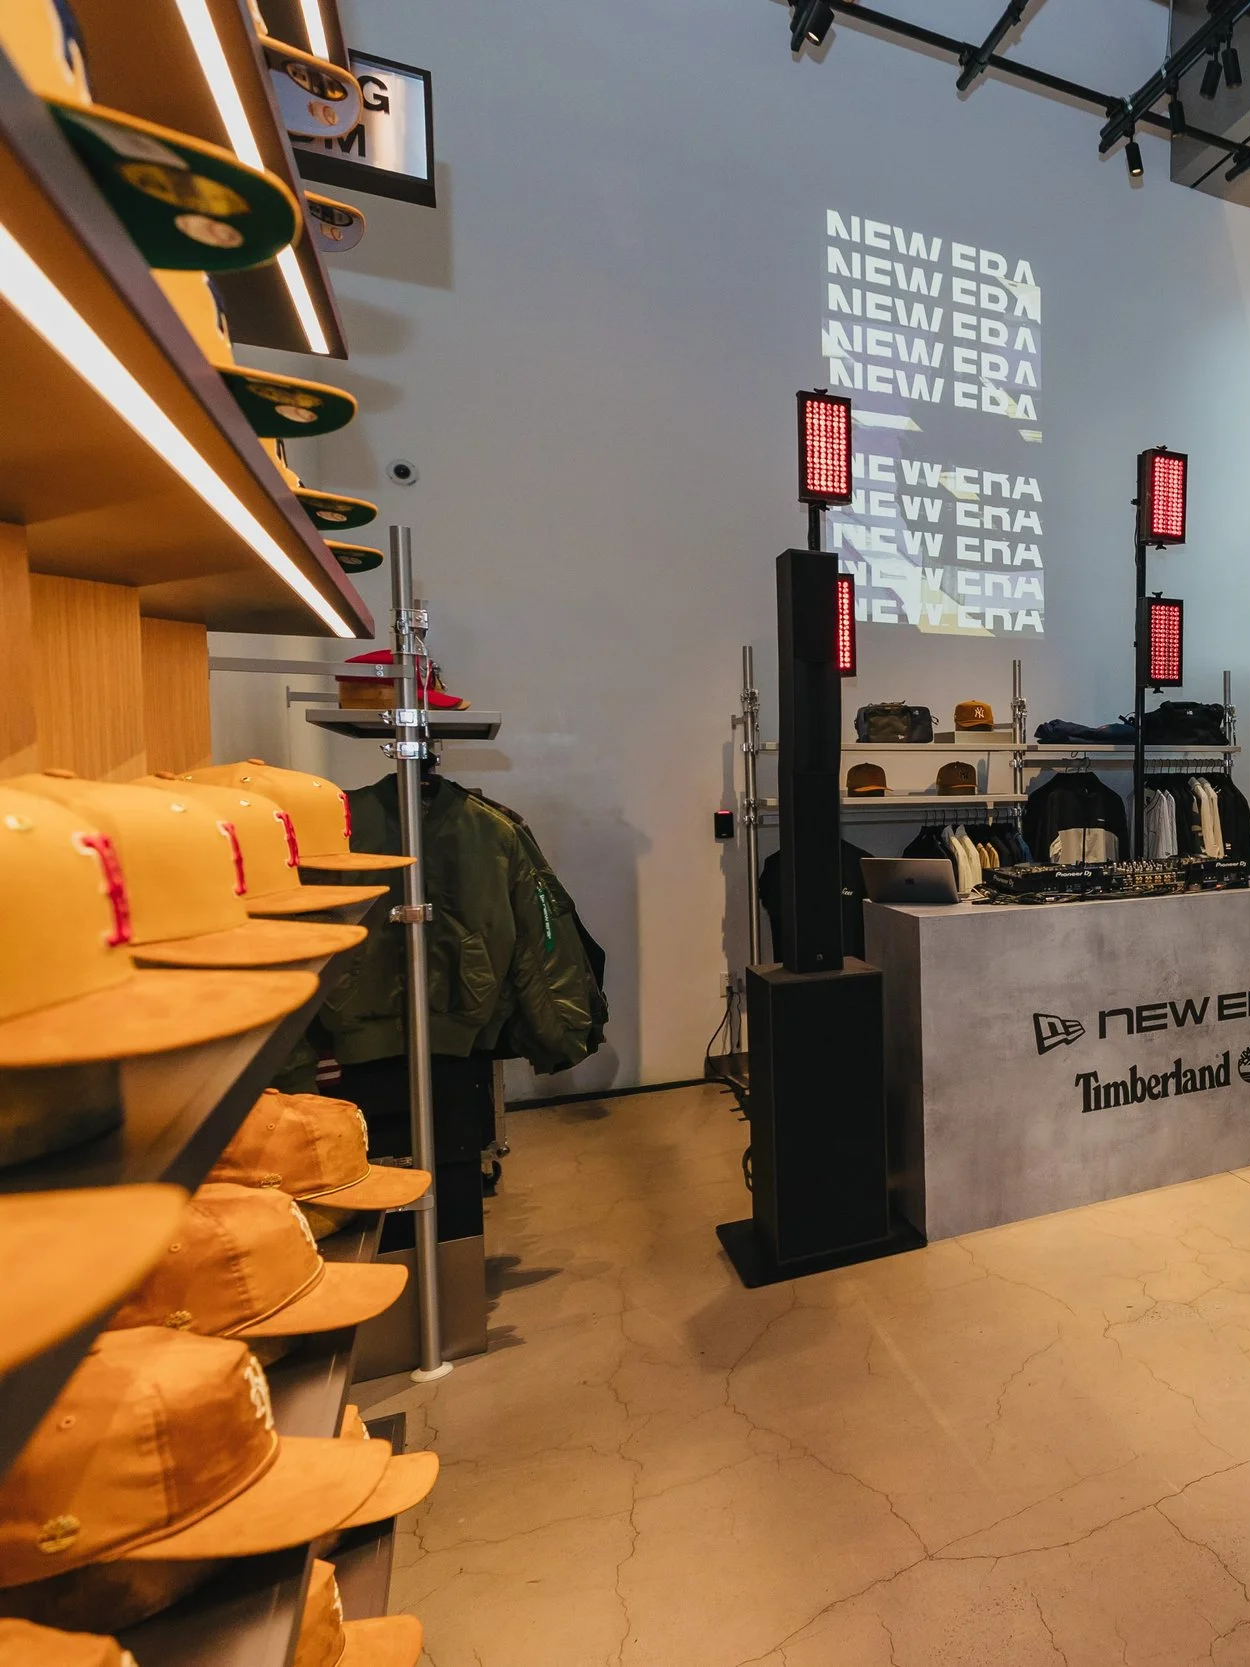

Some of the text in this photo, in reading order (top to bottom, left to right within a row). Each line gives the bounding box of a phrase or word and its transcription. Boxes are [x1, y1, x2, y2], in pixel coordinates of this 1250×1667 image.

[827, 209, 1036, 285] NEW ERA
[827, 246, 1038, 318] NEW ERA
[828, 282, 1037, 354] NEW ERA
[829, 319, 1037, 388] NEW ERA
[830, 357, 1037, 420] NEW ERA
[956, 467, 1042, 502] ERA
[956, 502, 1043, 535] ERA
[957, 535, 1043, 568] ERA
[957, 570, 1043, 600] ERA
[958, 606, 1044, 633] ERA
[1074, 1050, 1231, 1113] Timberland
